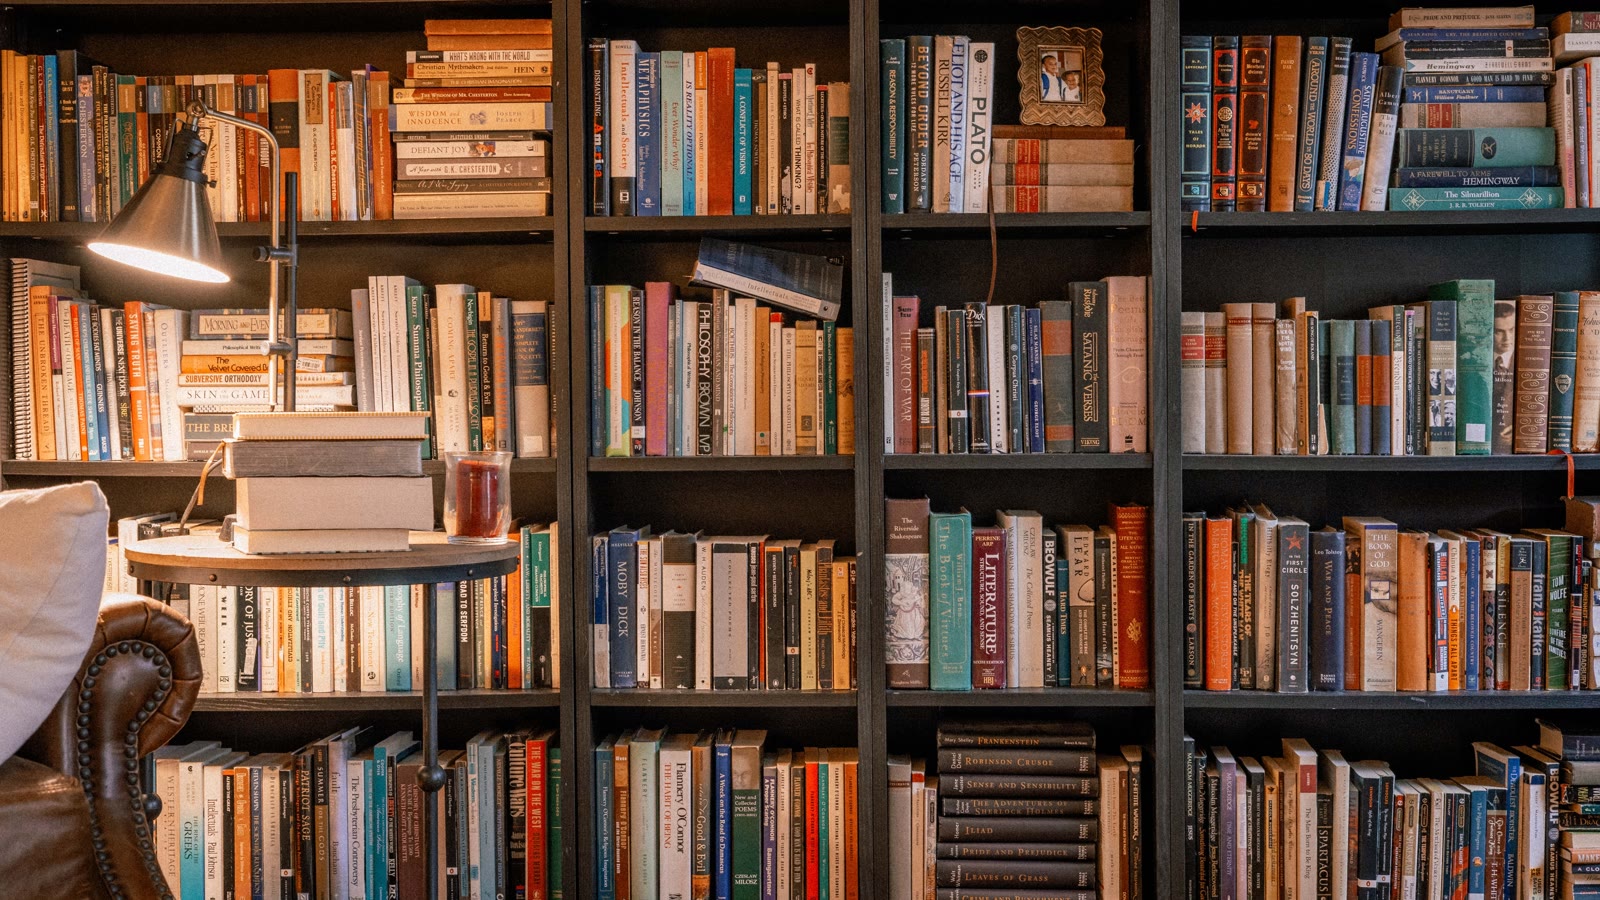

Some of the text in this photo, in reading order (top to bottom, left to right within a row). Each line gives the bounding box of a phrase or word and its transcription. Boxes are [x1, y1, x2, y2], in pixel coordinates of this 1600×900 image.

[620, 62, 629, 122] Intellectuals
[638, 59, 650, 137] METAPHYSICS
[918, 46, 929, 148] BEYOND ORDER
[937, 59, 949, 147] RUSSELL KIRK
[1309, 61, 1321, 101] AROUND
[79, 100, 87, 157] CHESTERTON
[949, 44, 964, 184] ELIOT AND HIS AGE
[970, 97, 987, 164] PLATO
[1305, 112, 1317, 145] WORLD
[1348, 89, 1361, 149] CONFESSIONS
[1358, 85, 1372, 154] SAINT AUGUSTINE
[449, 146, 466, 154] JOY
[594, 123, 604, 177] America
[619, 137, 630, 170] Society
[740, 137, 746, 146] OF
[1304, 153, 1313, 164] 80
[794, 146, 802, 189] THINKING?
[1302, 166, 1312, 189] DAYS
[1463, 177, 1520, 185] HEMINGWAY
[632, 296, 641, 324] REASON
[128, 313, 141, 378] SAVING TRUTH
[633, 335, 642, 350] THE
[633, 351, 642, 382] BALANCE
[185, 375, 262, 383] SUBVERSIVE ORTHODOXY
[698, 309, 711, 452] PHILOSOPHY BROWN IVP
[900, 329, 912, 422] THE ART OF WAR
[1083, 332, 1093, 422] SATANIC VERSES
[632, 389, 642, 421] JOHNSON
[1044, 540, 1055, 596] BEOWULF
[1074, 536, 1083, 577] LEAR
[1368, 542, 1392, 550] BOOK
[1370, 560, 1390, 568] GOD
[939, 523, 951, 658] The Book of Virtues
[1324, 560, 1333, 581] WAR
[1532, 573, 1545, 609] franz
[460, 600, 467, 609] TO
[617, 561, 628, 637] MOBY DICK
[984, 553, 999, 655] LITERATURE
[1325, 607, 1333, 636] PEACE
[1497, 590, 1507, 649] SILENCE
[460, 610, 468, 643] SERFDOM
[1289, 584, 1299, 665] SOLZHENITSYN
[1532, 617, 1545, 656] kafka
[1450, 619, 1458, 681] THINGS FALL APART
[965, 757, 1054, 766] ROBINSON CRUSOE
[978, 736, 1040, 745] FRANKENSTEIN
[316, 766, 325, 804] SUMMER
[509, 742, 526, 818] Culture Wars
[531, 746, 541, 829] THE WAR ON THE WEST
[966, 780, 1077, 790] SENSE AND SENSIBILITY
[1549, 768, 1560, 825] BEOWULF
[300, 770, 310, 841] PATRIOT SAGE
[664, 763, 672, 848] THE HABIT OF BEING
[674, 763, 687, 854] Flannery O'Connor
[183, 821, 193, 860] GREEKS
[207, 799, 218, 880] Intellectuals Paul Johnson
[350, 776, 361, 887] The Presbyterian Controversy
[965, 826, 994, 834] ILIAD
[1318, 829, 1328, 892] SPARTACUS
[1507, 853, 1515, 887] BALDWIN
